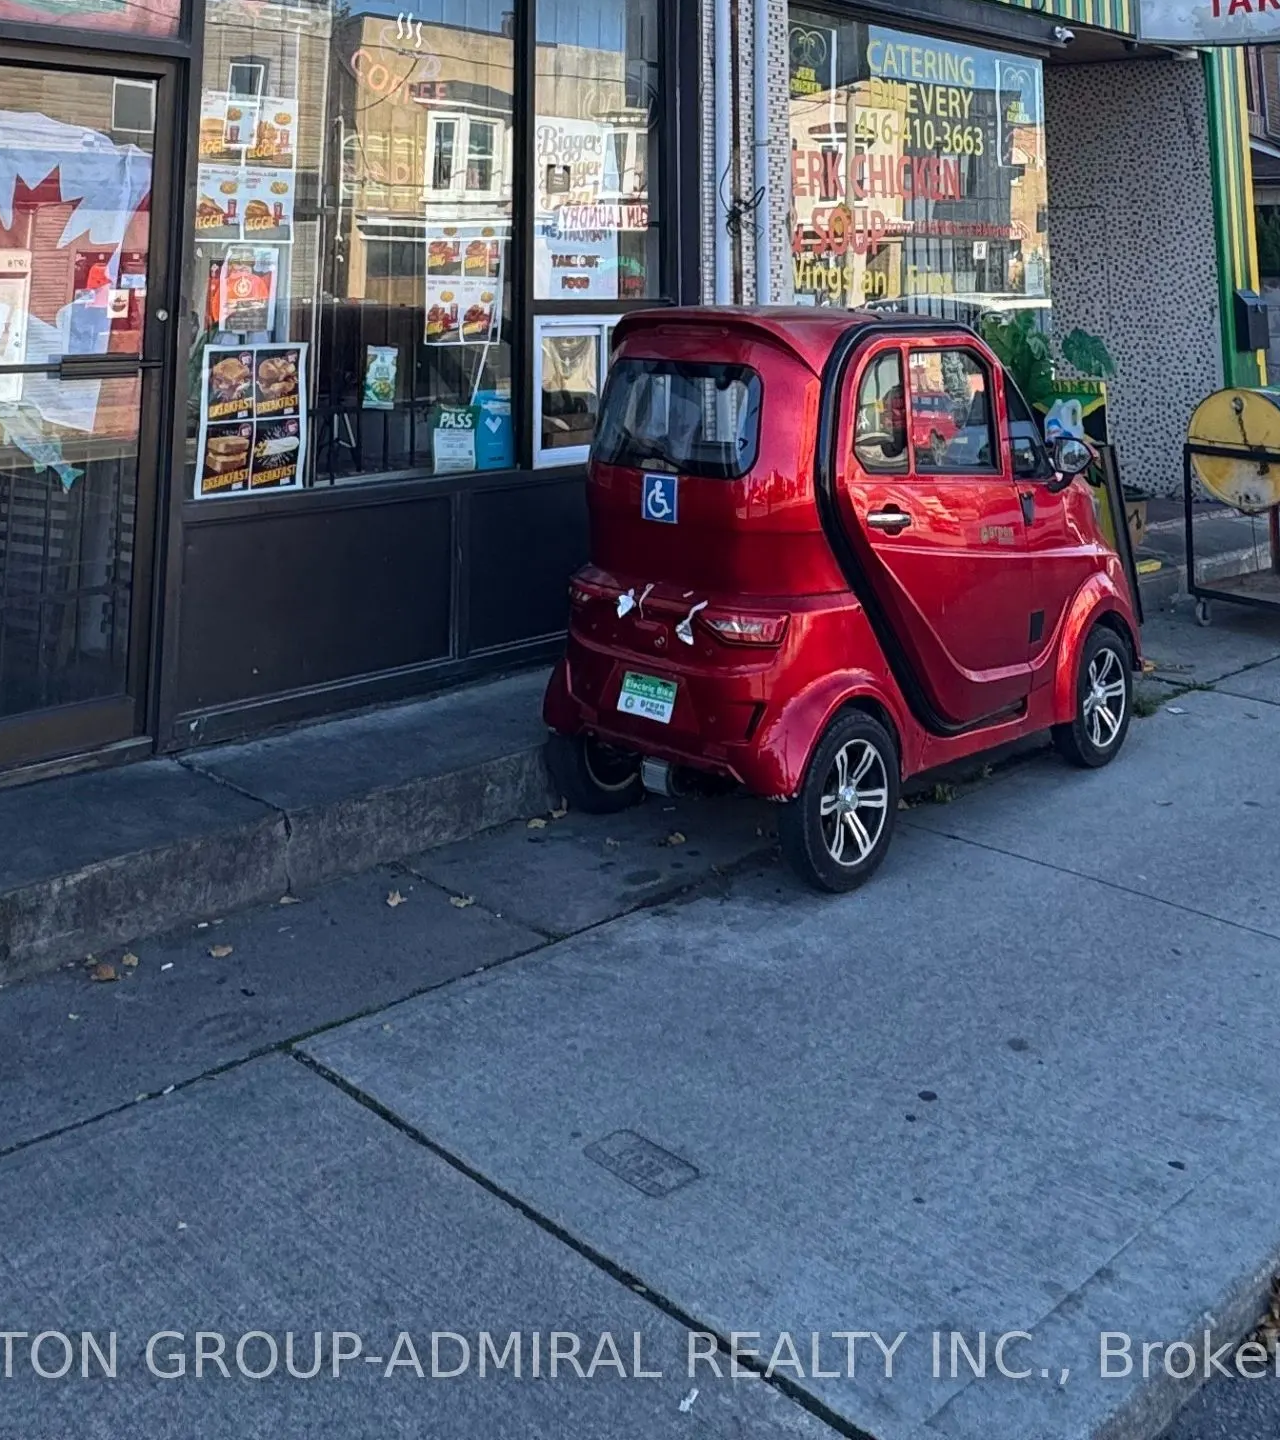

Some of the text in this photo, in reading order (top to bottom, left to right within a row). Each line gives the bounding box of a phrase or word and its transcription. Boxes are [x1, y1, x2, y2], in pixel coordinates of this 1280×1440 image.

[867, 40, 975, 87] CATERING
[536, 124, 603, 162] Bigger
[855, 111, 984, 156] 416-410-3663
[850, 153, 961, 201] CHICKEN
[811, 207, 885, 256] SOUP
[439, 412, 472, 428] PASS
